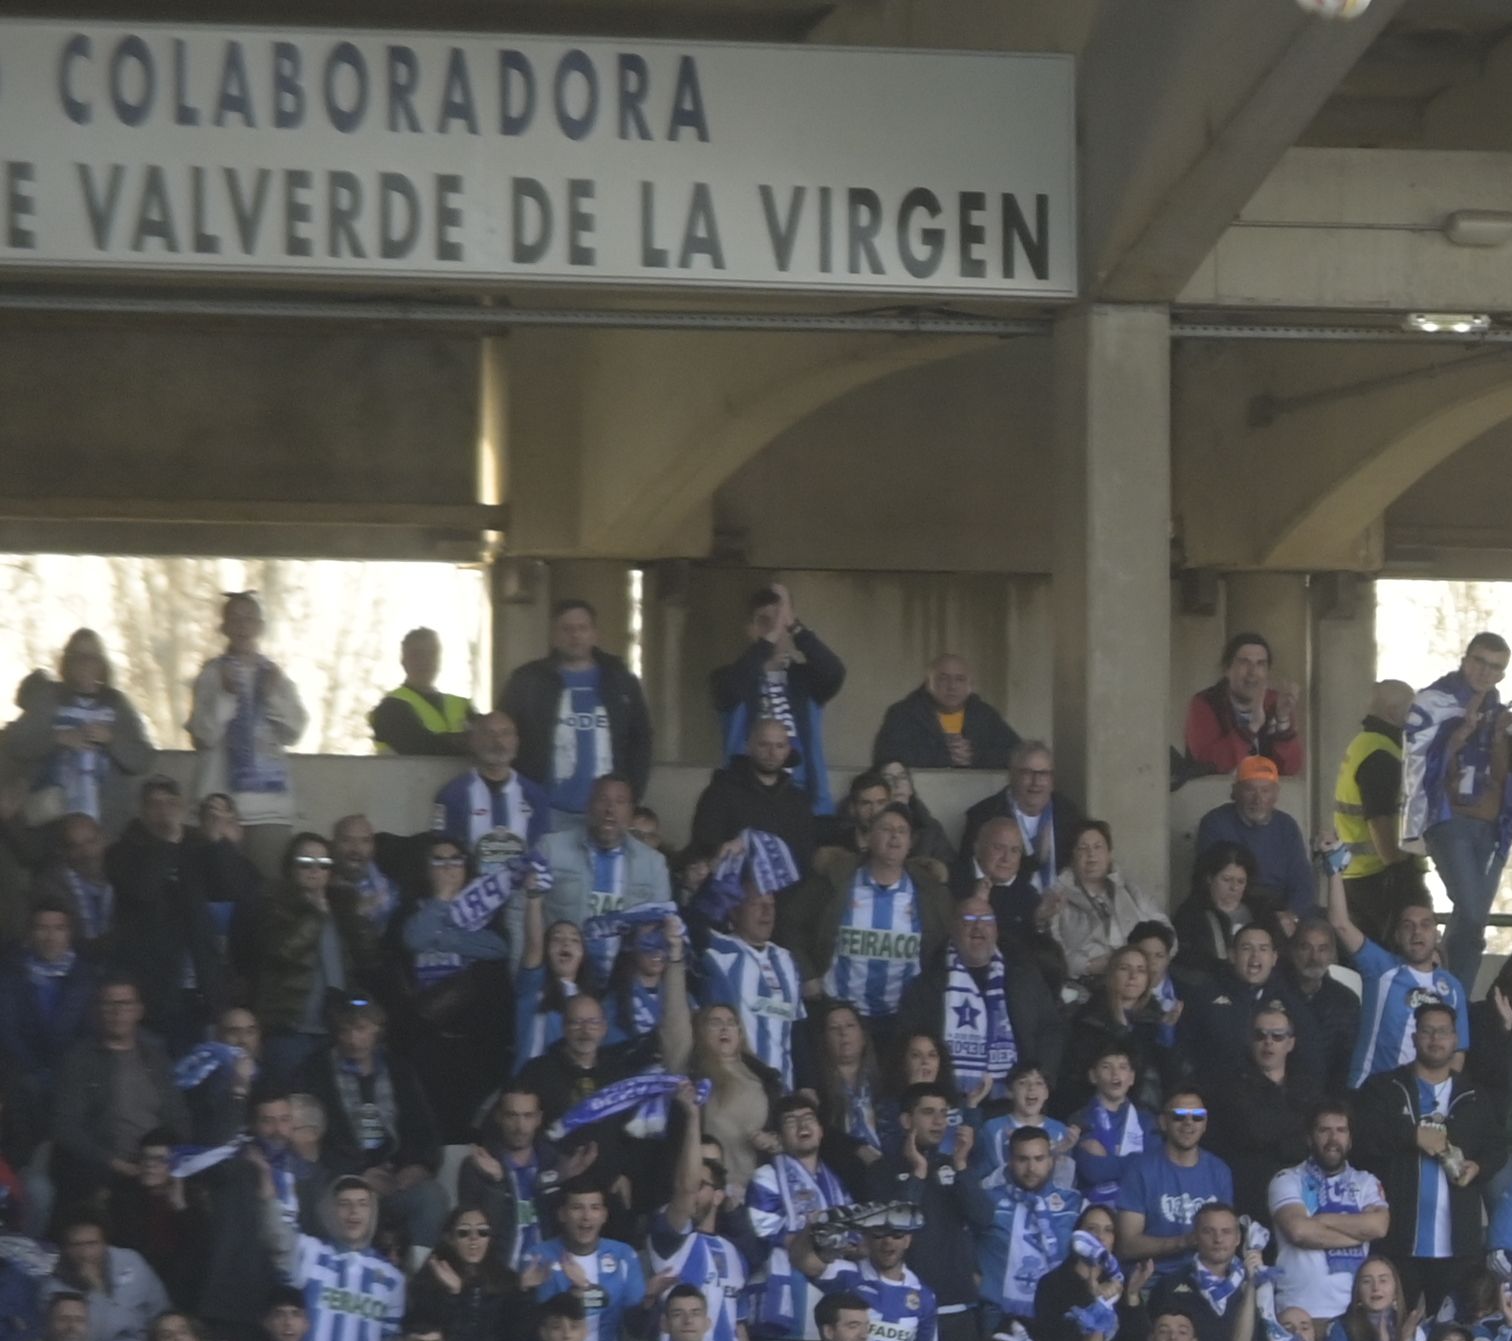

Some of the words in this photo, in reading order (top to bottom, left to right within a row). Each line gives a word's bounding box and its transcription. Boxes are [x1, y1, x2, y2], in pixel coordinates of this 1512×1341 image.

[58, 33, 712, 145] COLABORADORA
[75, 164, 466, 263] VALVERDE
[511, 177, 597, 267] DE
[639, 180, 727, 272] LA
[757, 184, 1050, 281] VIRGEN
